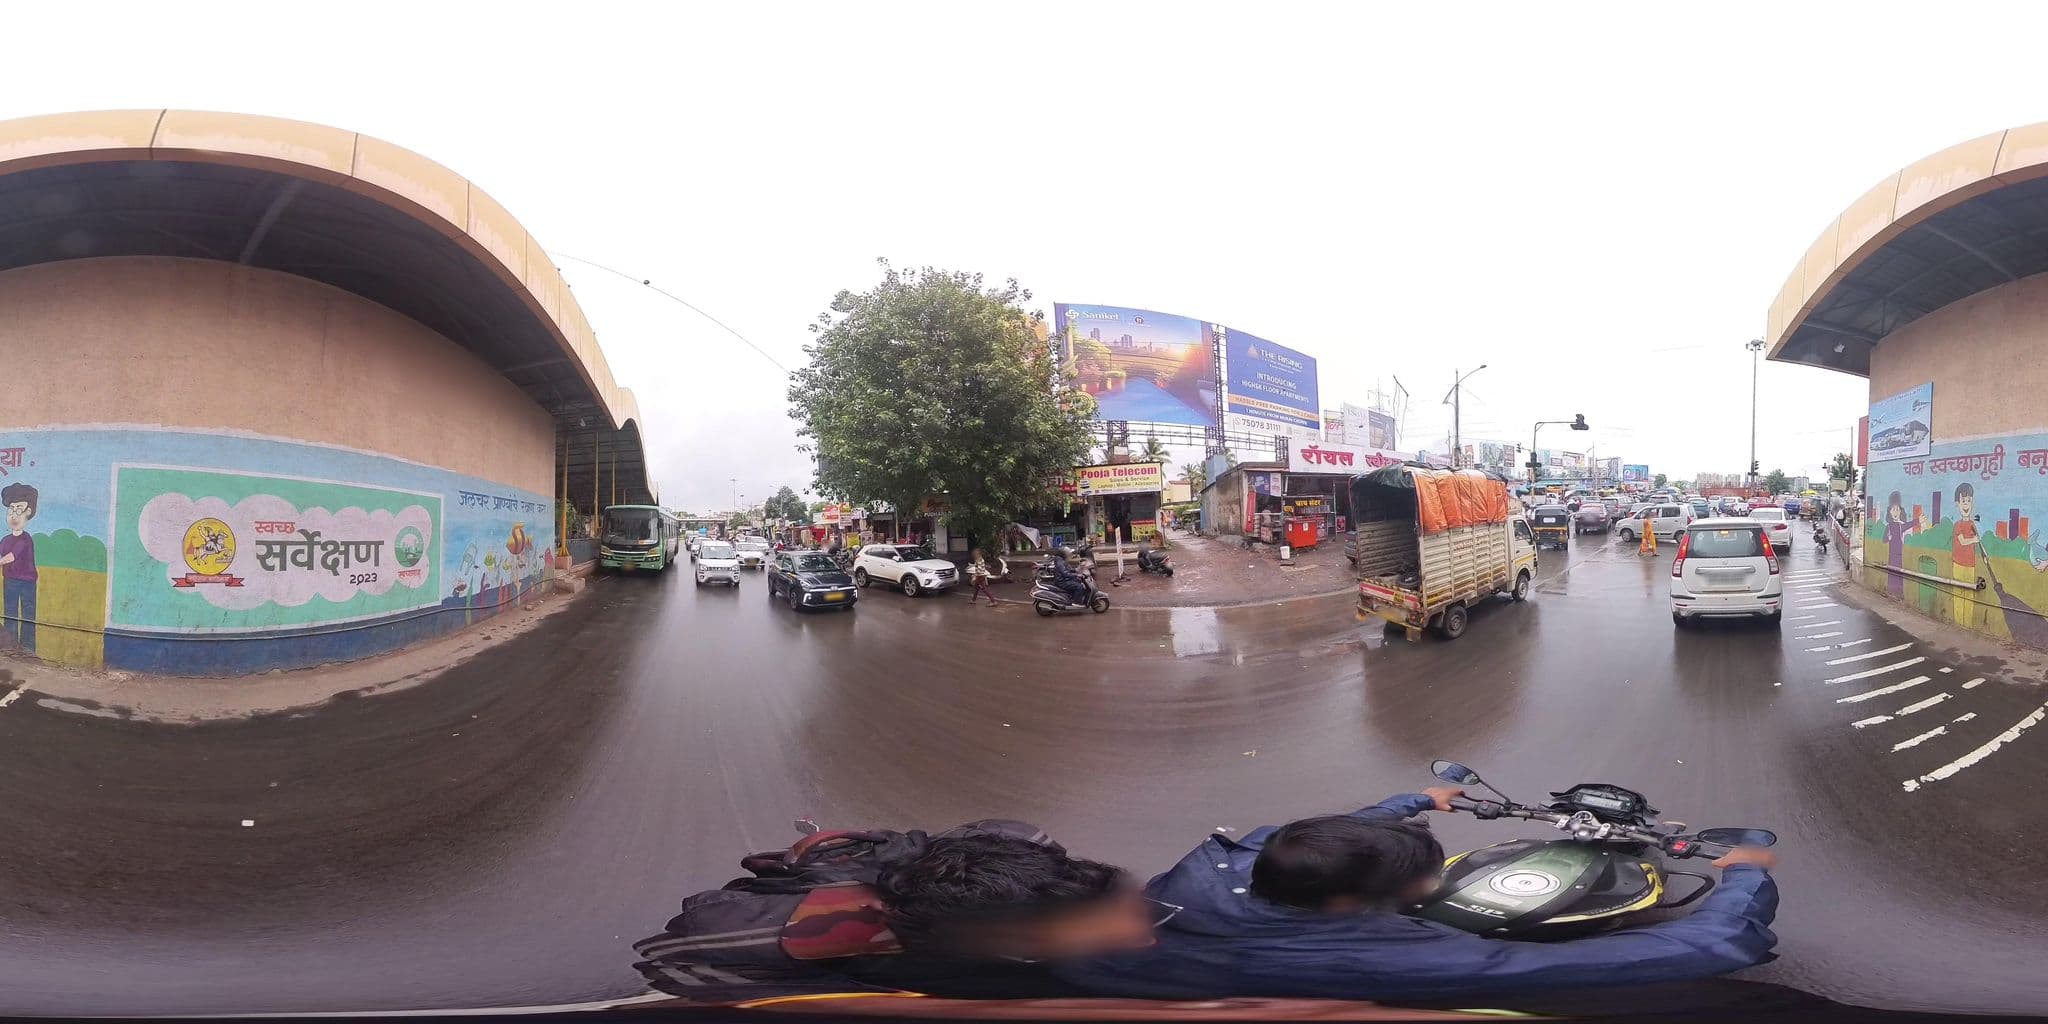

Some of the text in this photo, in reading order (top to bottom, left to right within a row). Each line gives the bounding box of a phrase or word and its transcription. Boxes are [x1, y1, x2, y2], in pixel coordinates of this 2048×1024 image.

[1261, 349, 1275, 360] THE
[1256, 371, 1297, 389] INTRODUCING
[1241, 418, 1265, 429] 75078
[1301, 444, 1354, 466] रॉयल
[1081, 466, 1157, 479] Pooja Telecom
[1903, 461, 1925, 476] चला
[458, 490, 490, 510] जलचर
[255, 520, 296, 534] स्वच्छ
[255, 528, 384, 576] सर्वेक्षण
[349, 573, 378, 586] 2023
